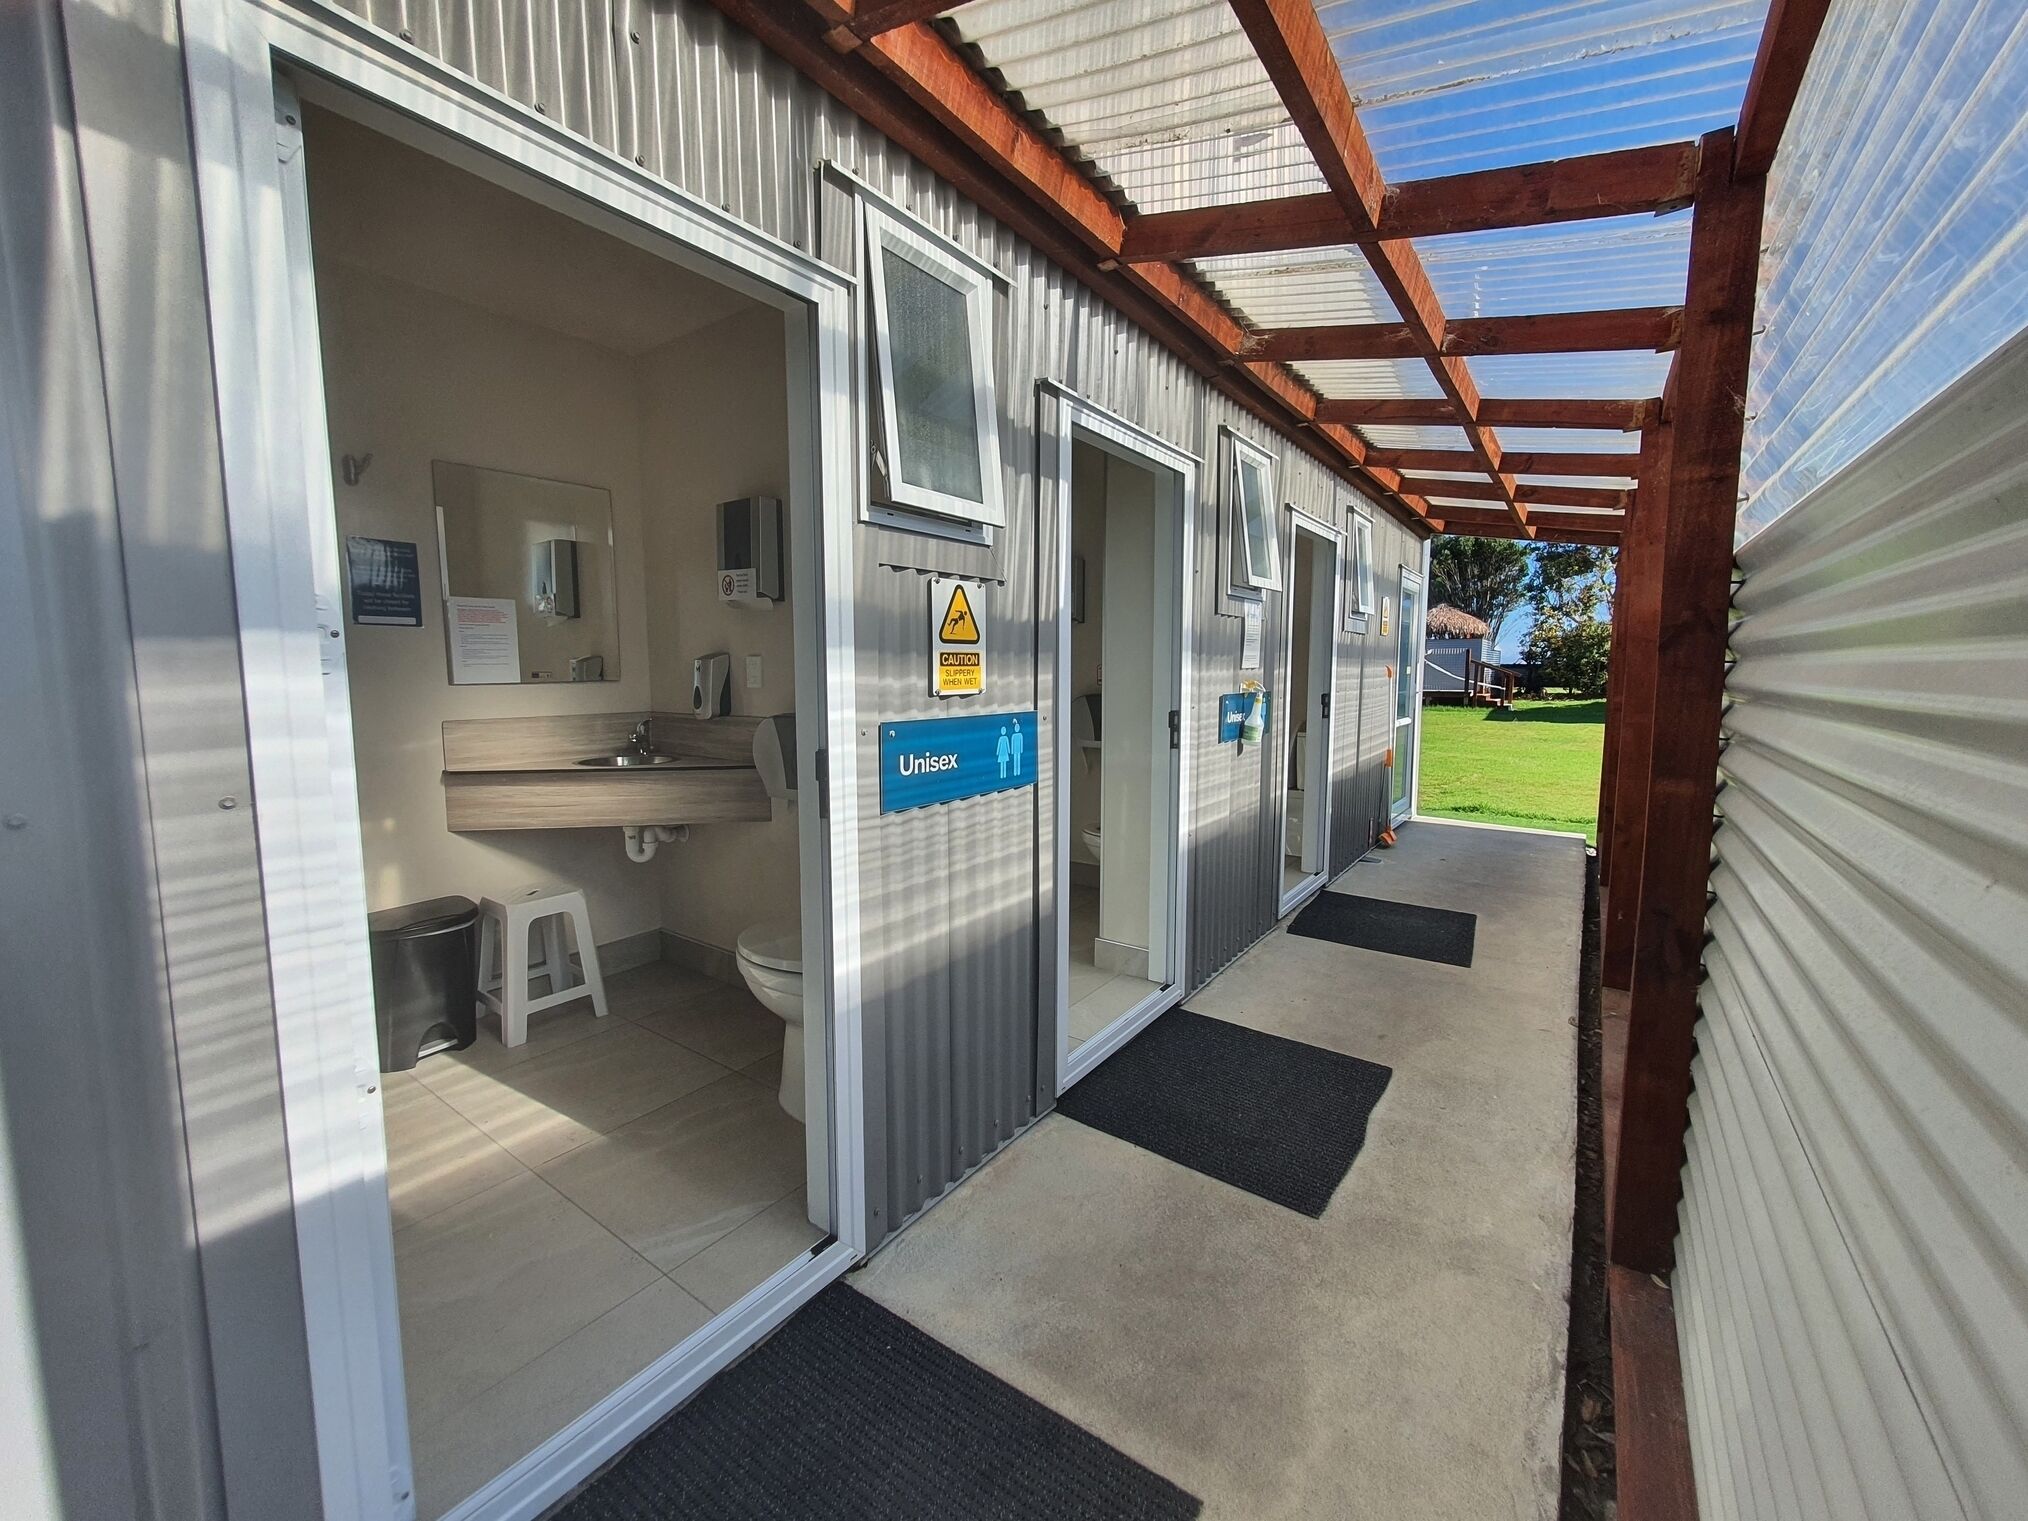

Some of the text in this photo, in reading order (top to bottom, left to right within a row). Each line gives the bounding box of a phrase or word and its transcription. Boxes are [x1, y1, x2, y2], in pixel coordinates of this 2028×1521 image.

[942, 654, 978, 665] CAUTION
[945, 669, 975, 677] SLIPPERY
[943, 677, 978, 686] WHEN WET
[900, 751, 958, 776] Unisex
